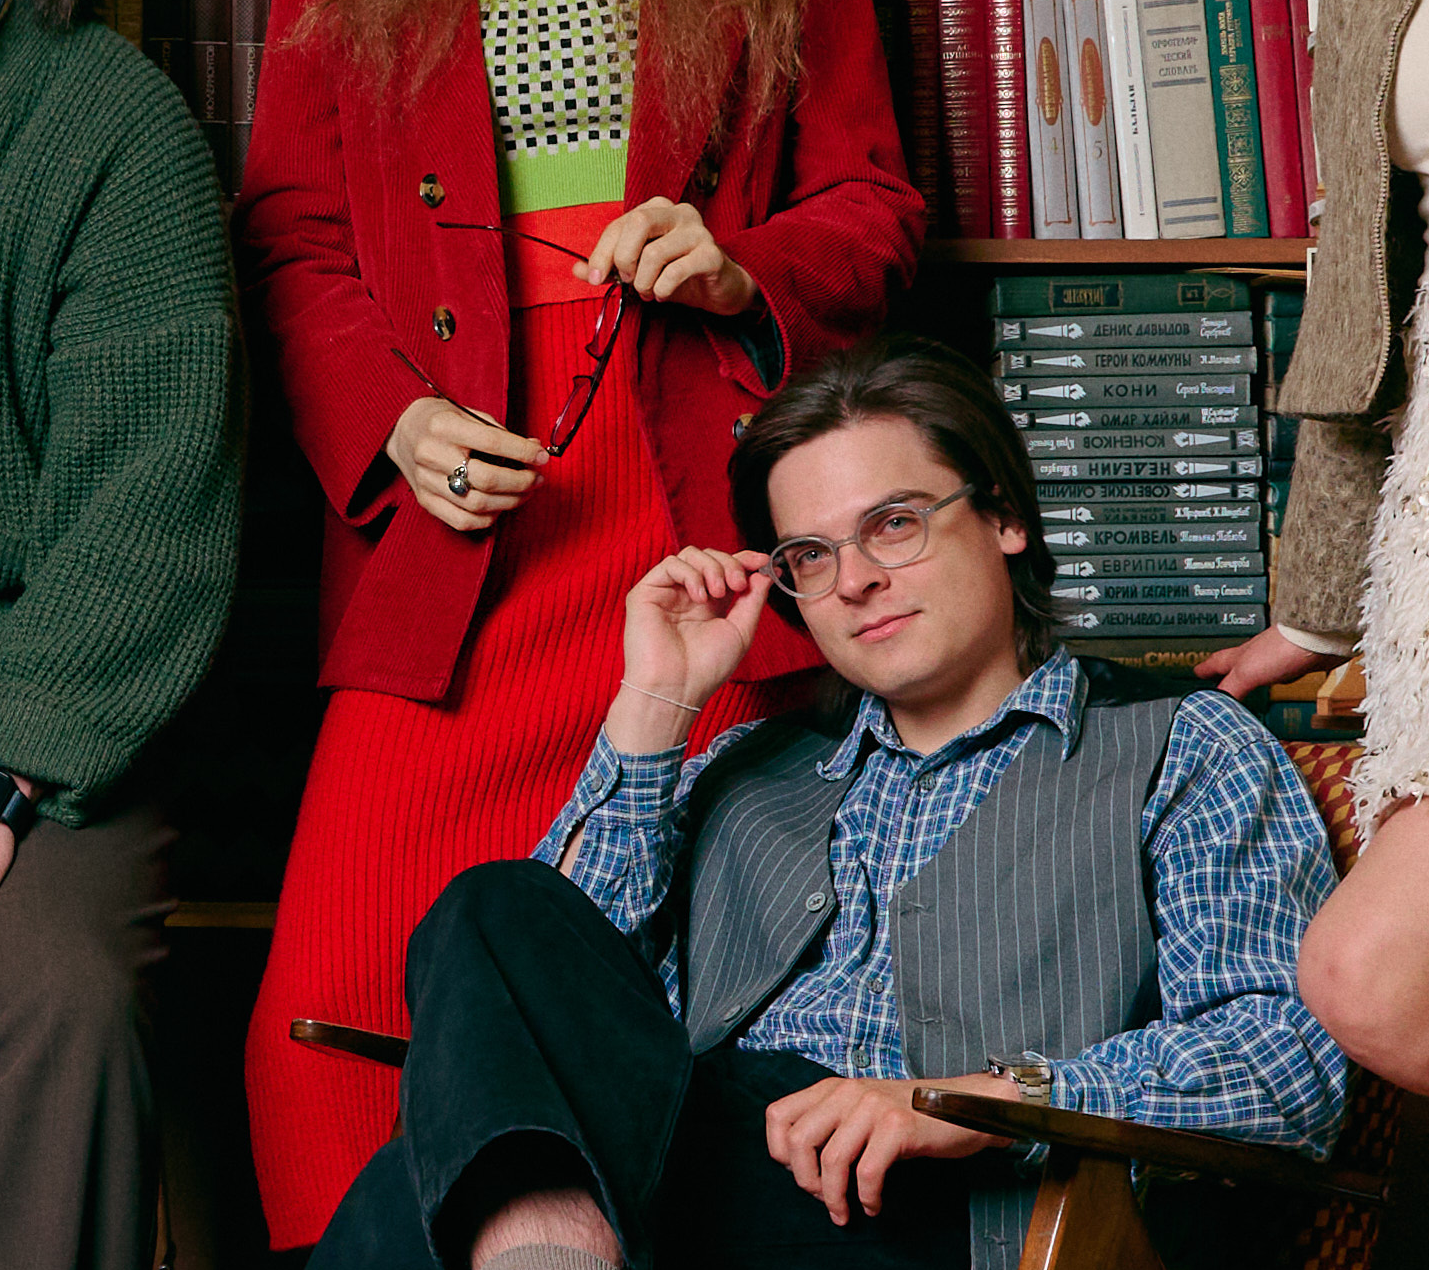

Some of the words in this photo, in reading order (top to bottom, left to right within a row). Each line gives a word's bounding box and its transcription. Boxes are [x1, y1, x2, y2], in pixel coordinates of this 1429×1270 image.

[1093, 324, 1133, 338] ДЕНИС
[1136, 323, 1190, 337] ДАВЫДОВ
[1095, 355, 1130, 368] ГЕРОИ
[1132, 353, 1191, 367] КОММУНЫ
[1103, 384, 1157, 398] КОНИ
[1101, 414, 1137, 427] ОМАР
[1142, 412, 1190, 427] ХАЙЯМ
[1083, 435, 1166, 450] КОНЕНКОВ
[1089, 462, 1171, 478] НЕДЕЛИН
[1101, 483, 1170, 498] СОВЕТСКИЕ
[1094, 530, 1178, 546] КРОМВЕЛЬ
[1103, 558, 1178, 573] ЕВРИПИД
[1104, 585, 1138, 598] ЮРИЙ
[1142, 585, 1190, 597] ГАГАРИН
[1102, 613, 1162, 626] ЛЕОНАРДО
[1177, 612, 1219, 626] ВИНЧИ
